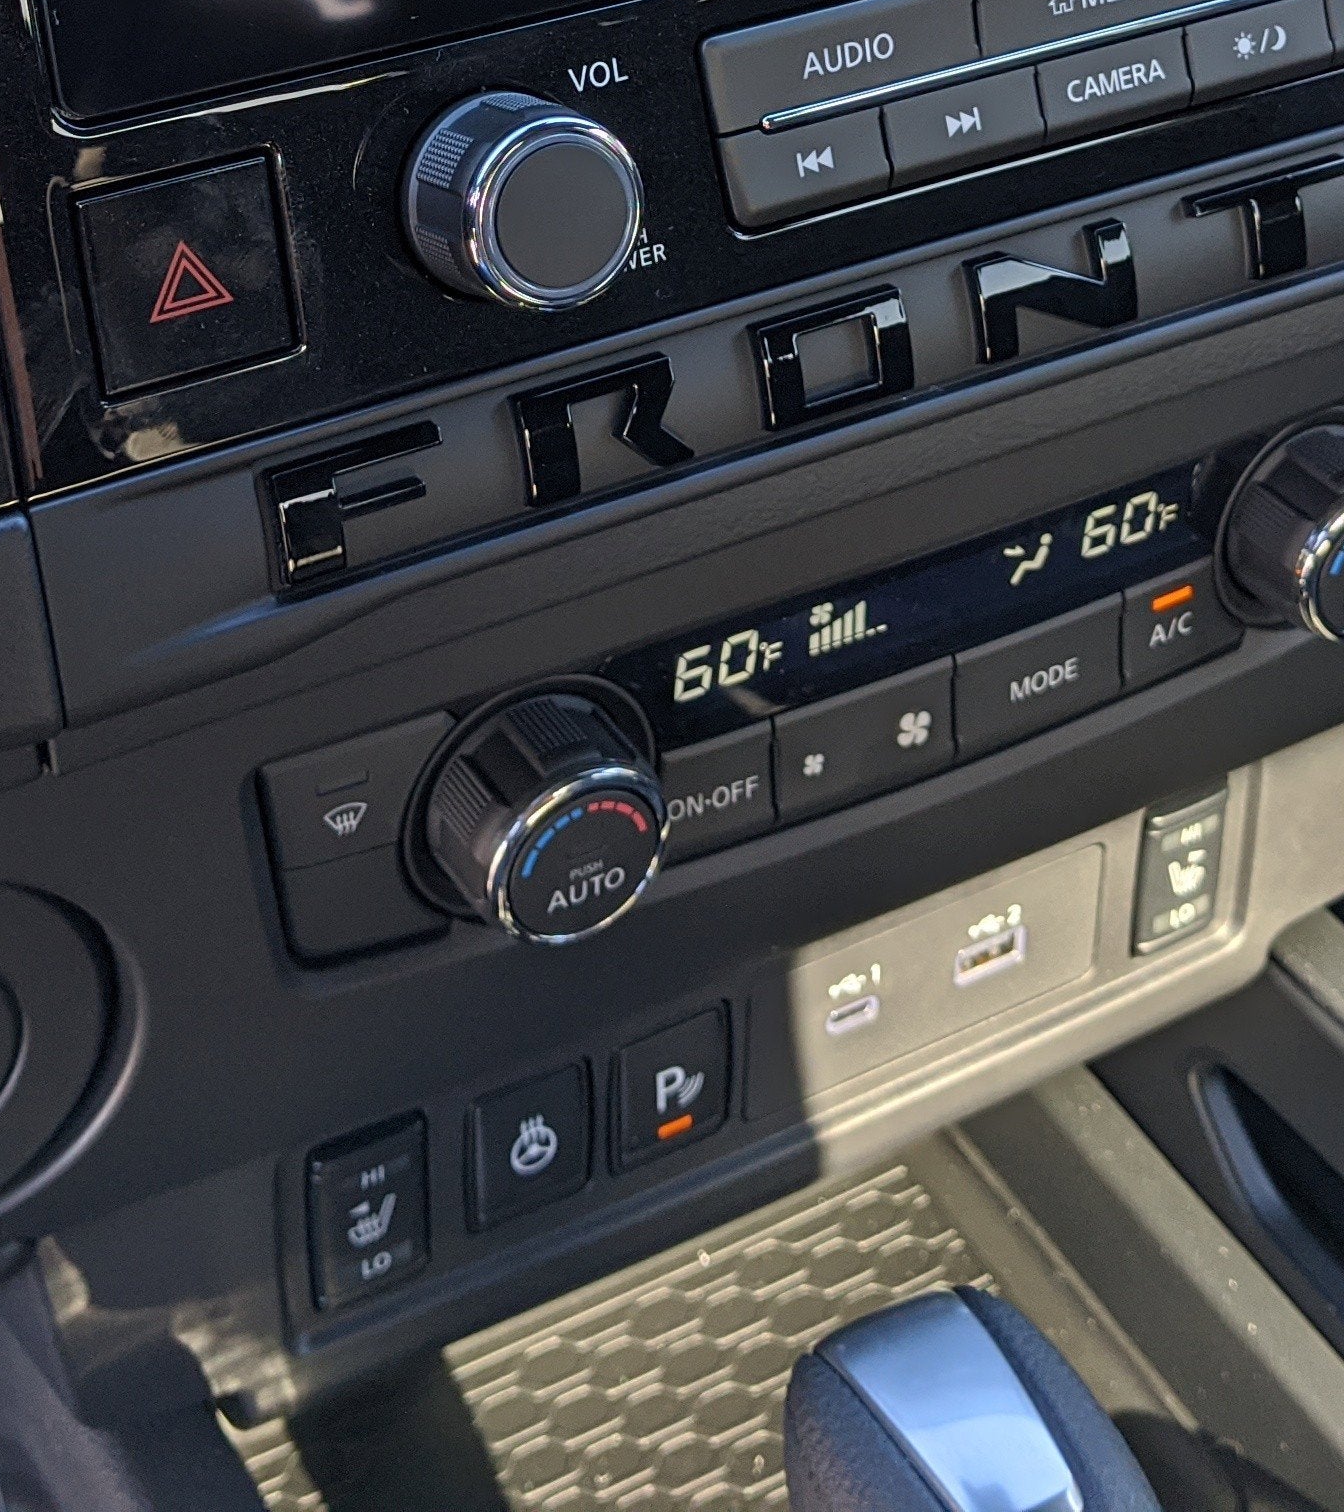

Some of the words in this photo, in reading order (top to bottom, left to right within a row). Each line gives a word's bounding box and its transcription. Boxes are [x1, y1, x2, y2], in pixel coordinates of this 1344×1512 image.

[567, 56, 630, 93] VOL
[801, 31, 896, 80] AUDIO
[1065, 56, 1167, 106] CAMERA
[1148, 610, 1194, 648] A/C
[1008, 655, 1081, 703] MODE
[546, 865, 626, 914] AUTO
[655, 1065, 687, 1115] P
[360, 1250, 393, 1281] LO
